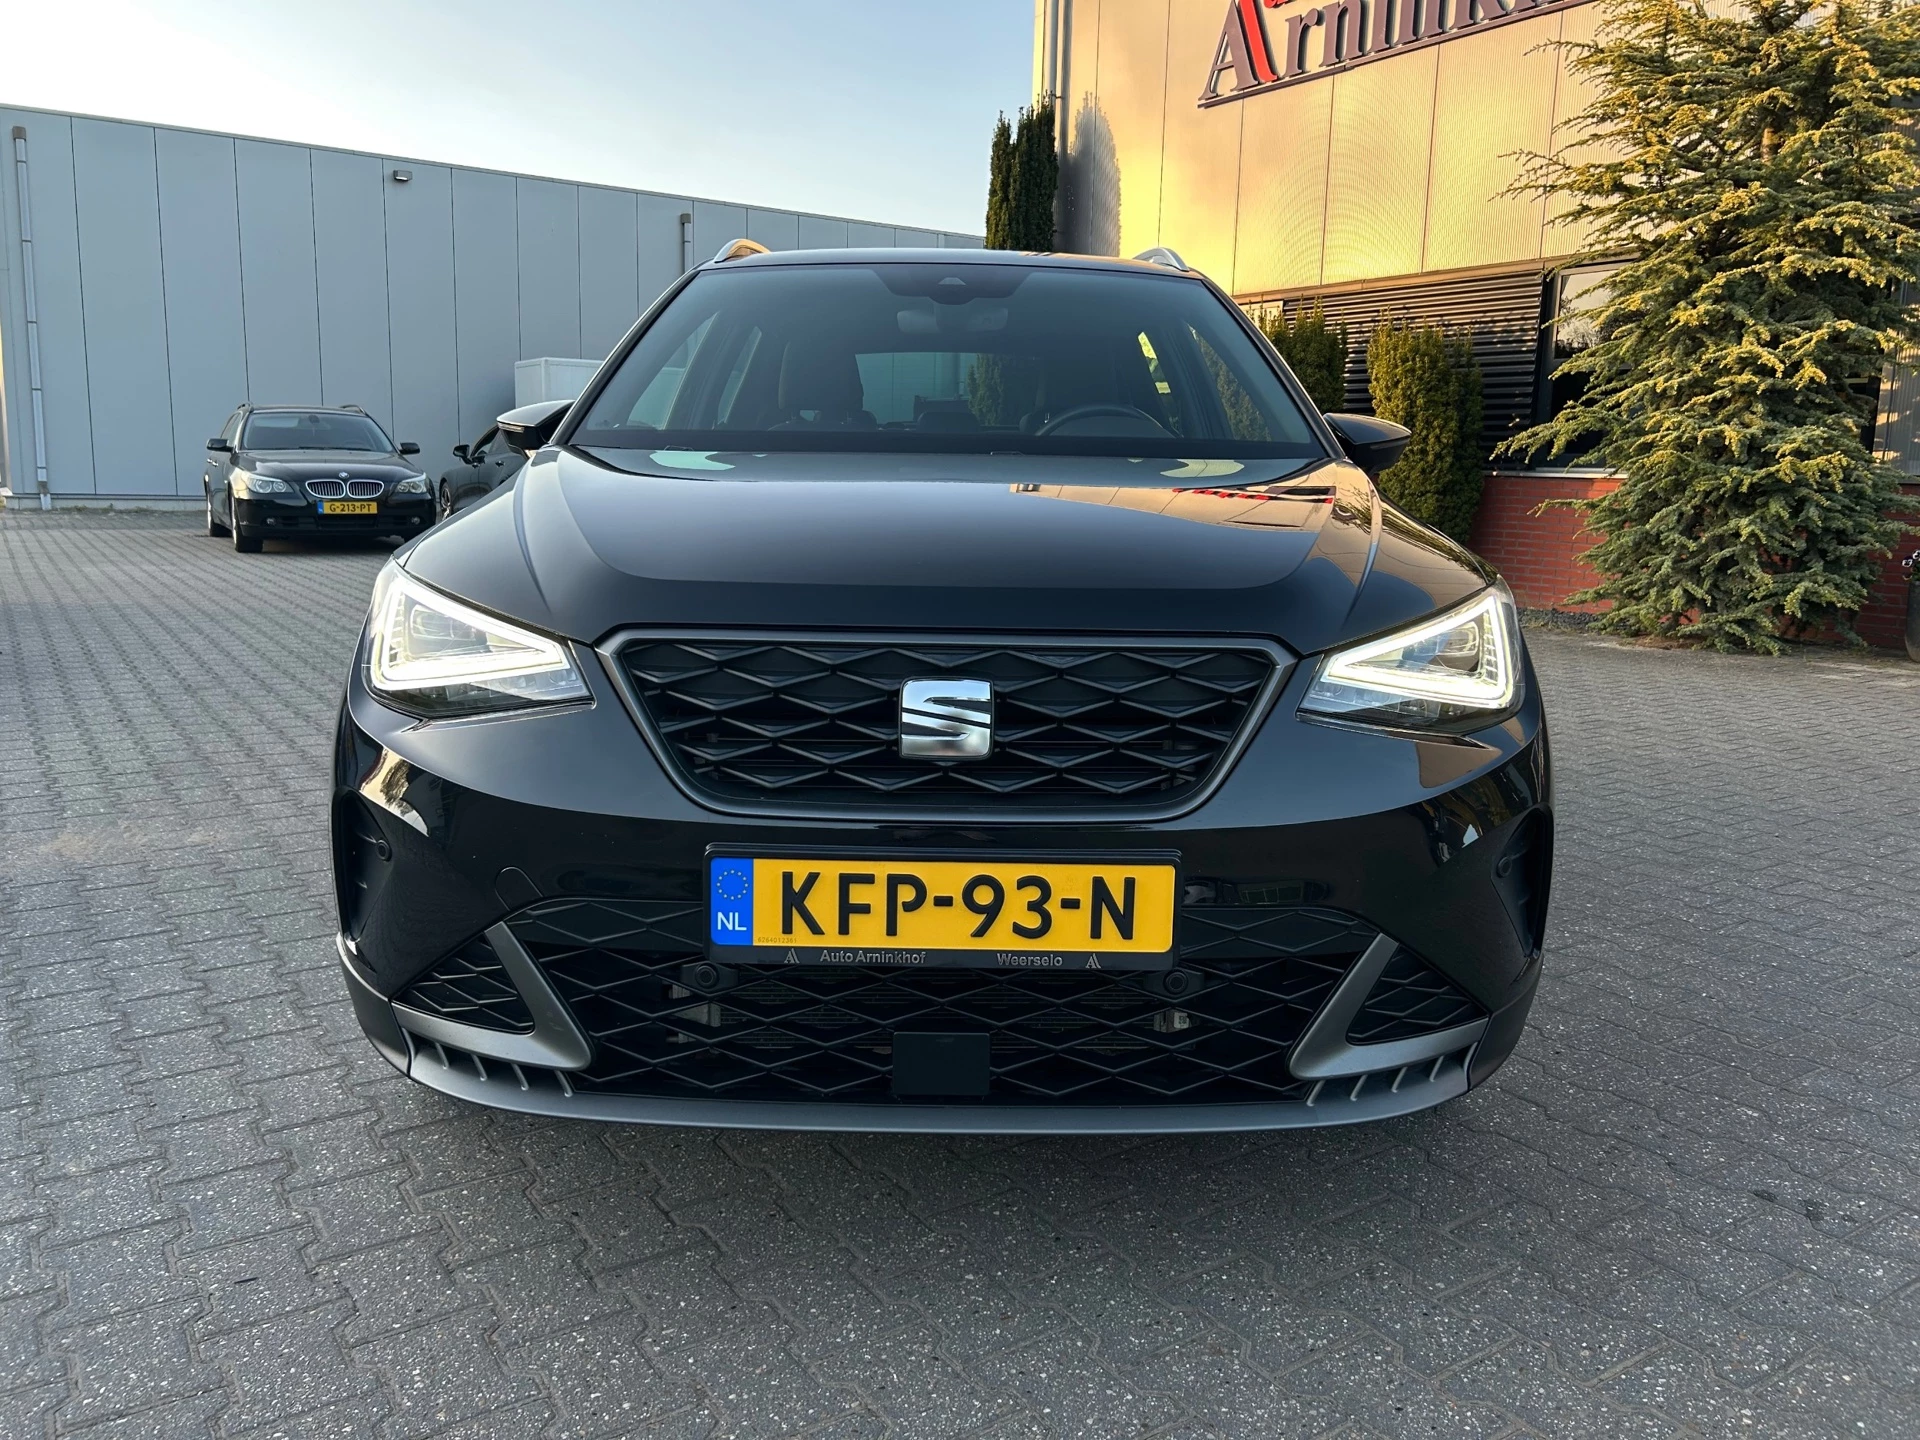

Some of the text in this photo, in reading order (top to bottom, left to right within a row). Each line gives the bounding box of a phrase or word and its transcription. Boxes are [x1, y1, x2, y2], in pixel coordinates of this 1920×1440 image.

[329, 503, 372, 513] G-213-PT
[781, 871, 1136, 939] KFP-93-N
[717, 911, 747, 931] NL
[820, 950, 926, 964] Auto Arninkhof
[997, 952, 1063, 966] Weerselo
